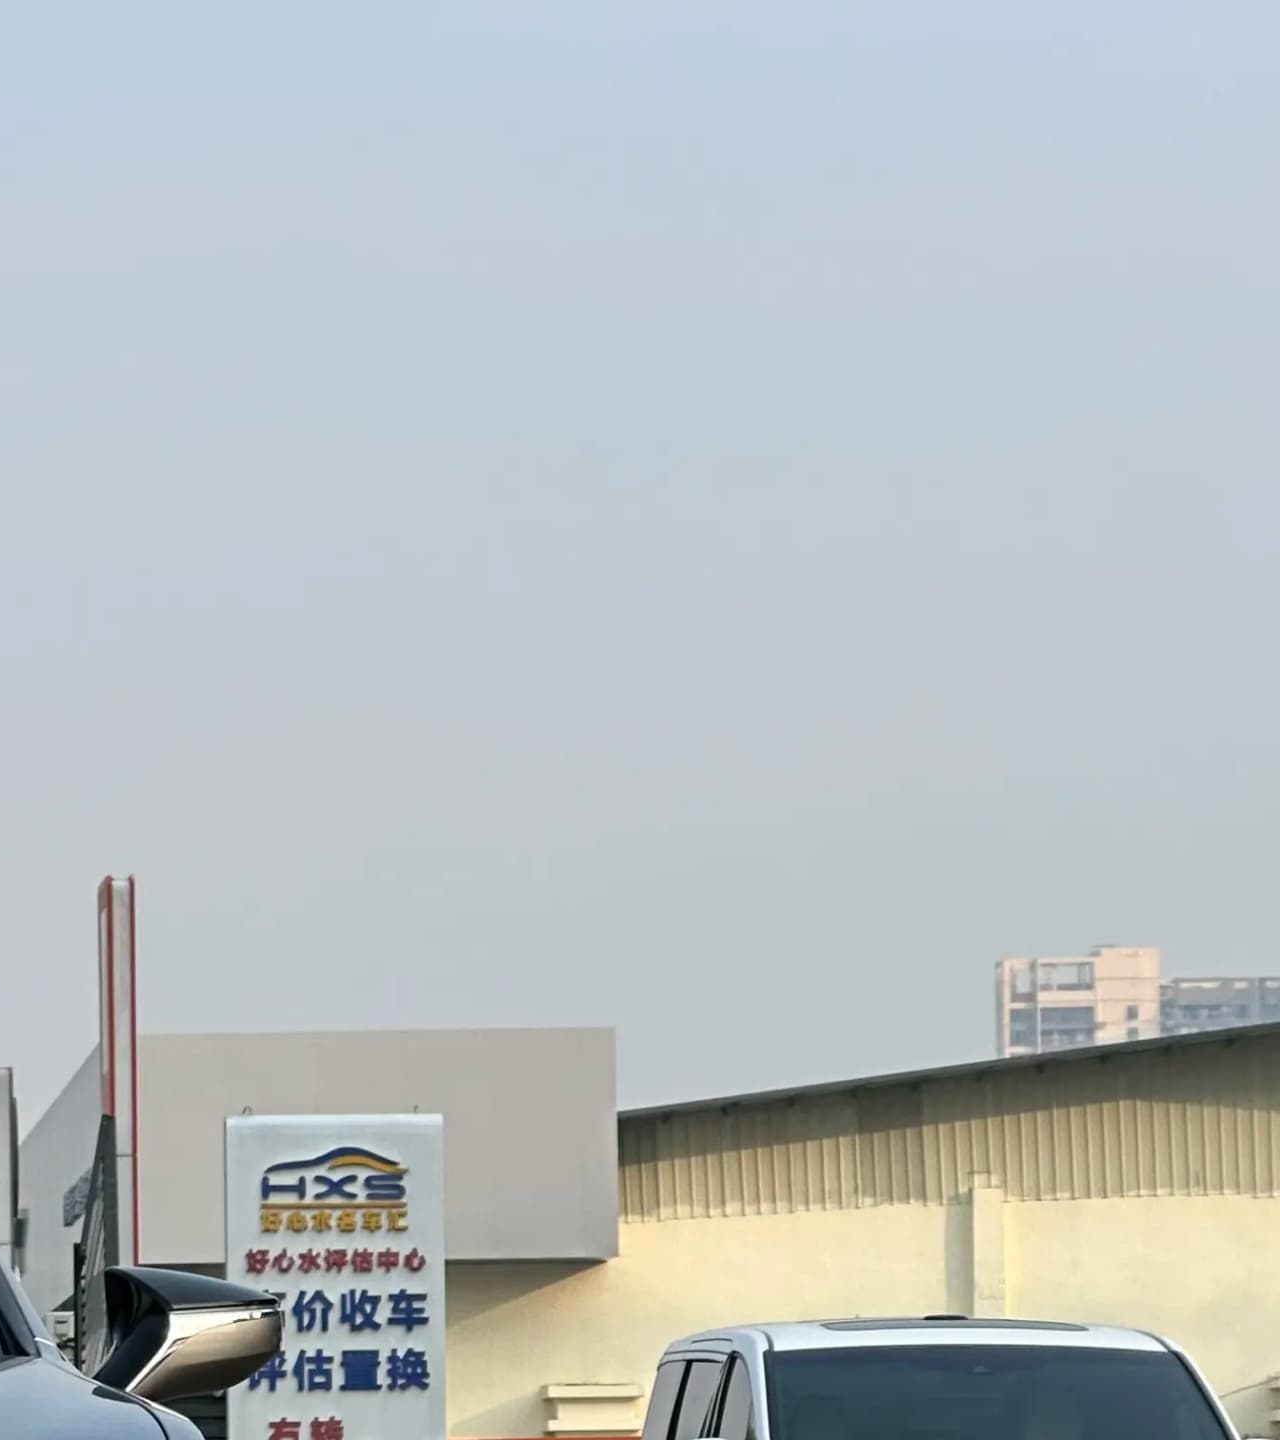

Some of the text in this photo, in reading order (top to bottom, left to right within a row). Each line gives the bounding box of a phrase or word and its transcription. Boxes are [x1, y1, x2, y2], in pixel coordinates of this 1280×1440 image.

[261, 1174, 407, 1200] HXS
[246, 1248, 427, 1273] 好心水评估中心
[263, 1289, 429, 1332] 价收车
